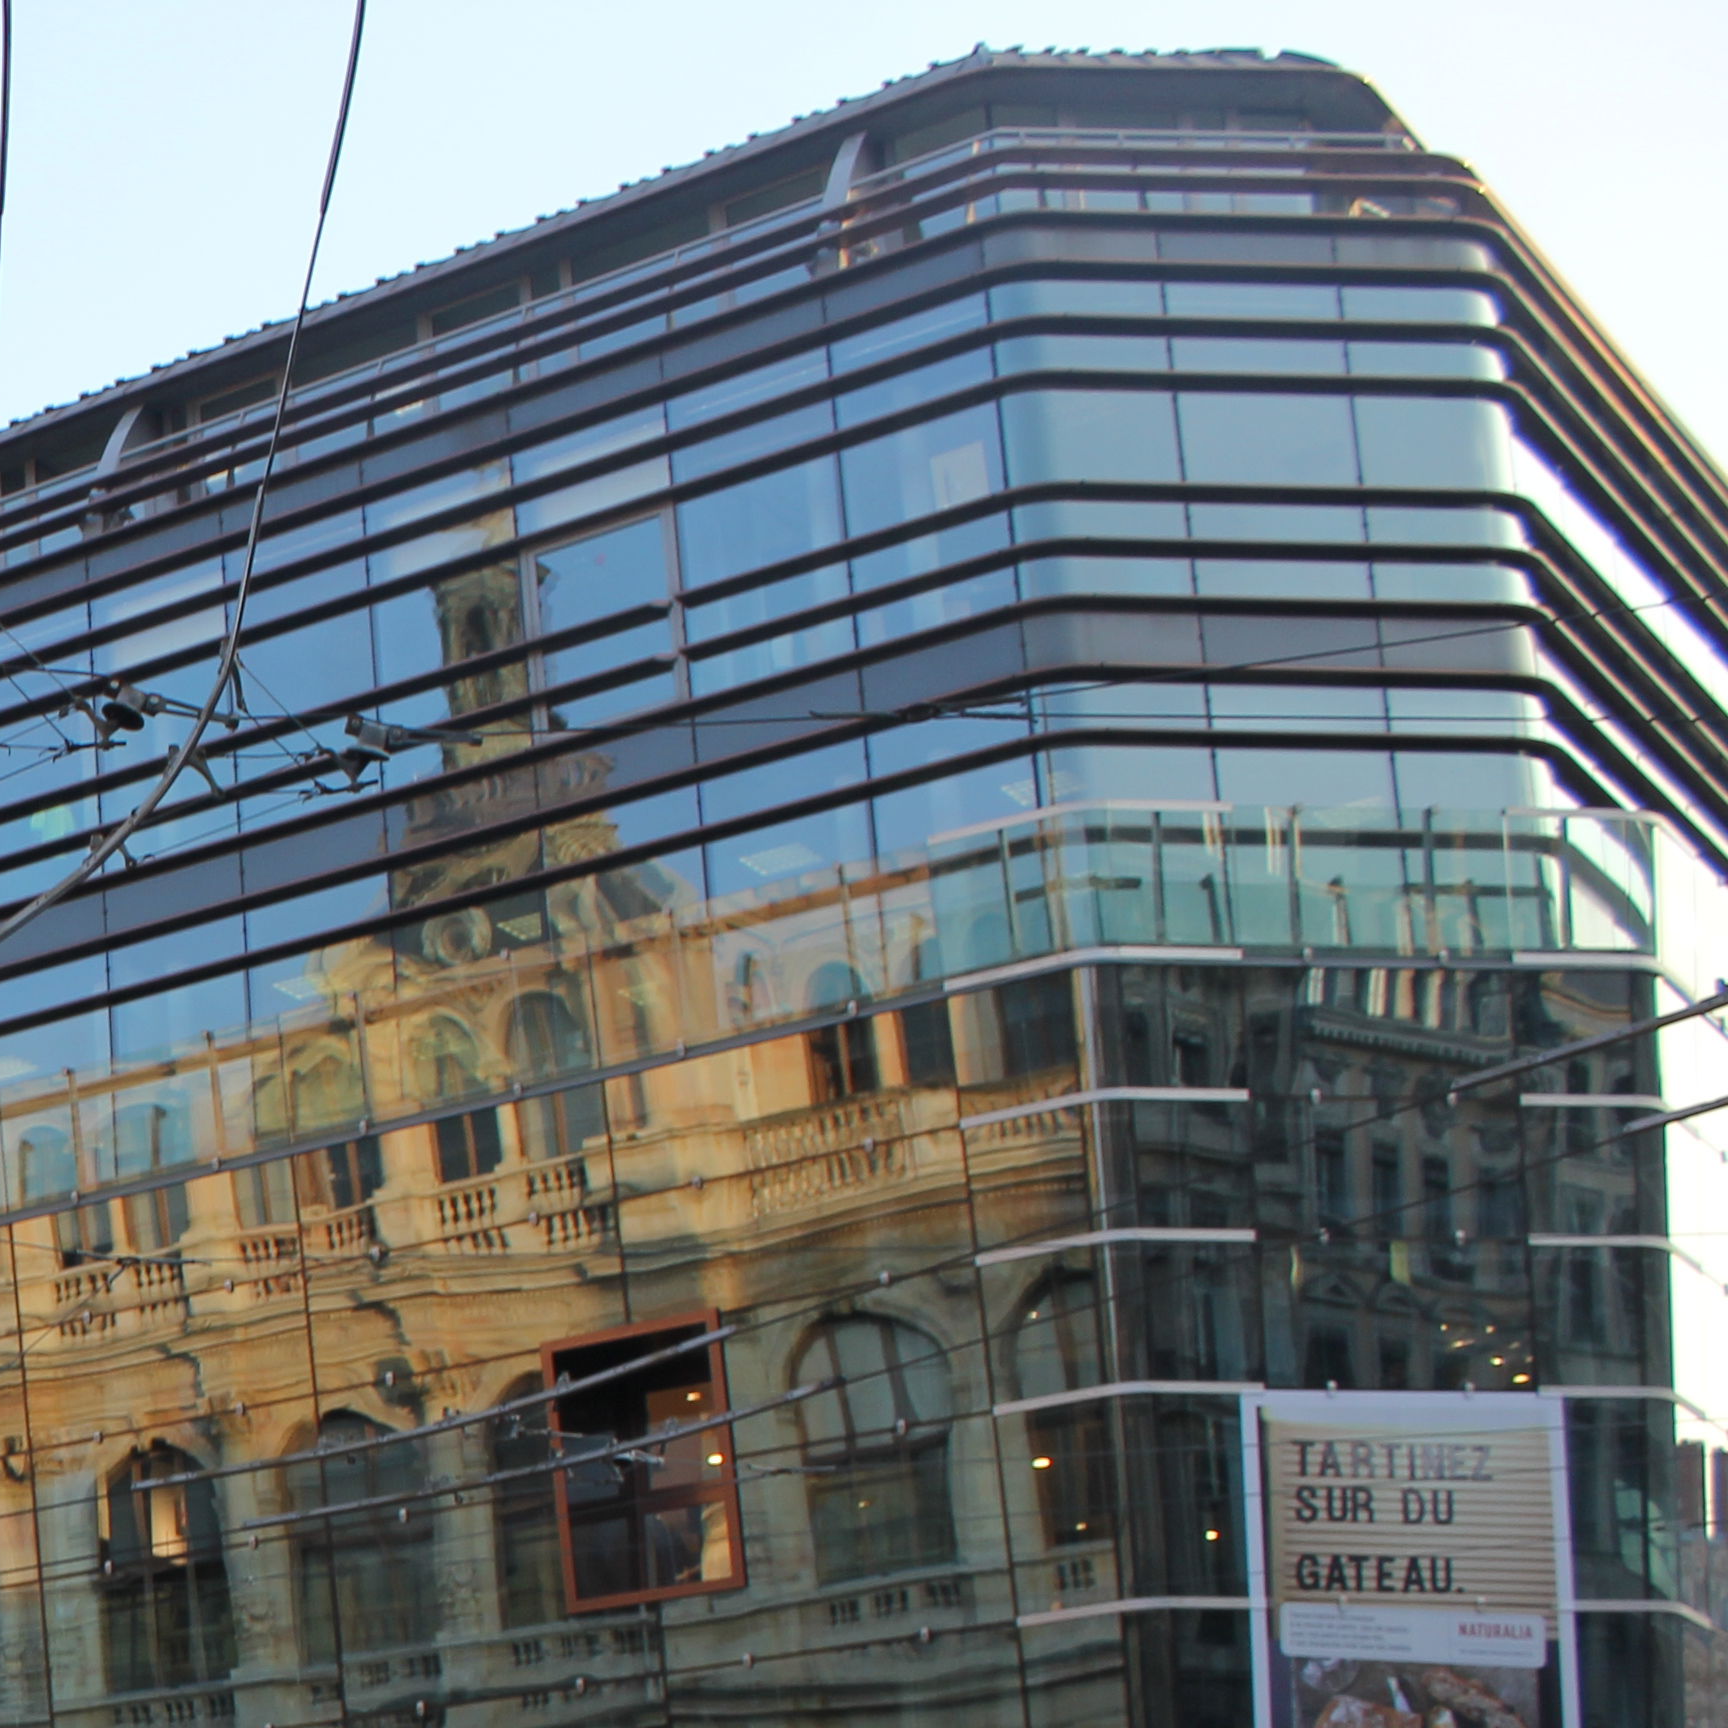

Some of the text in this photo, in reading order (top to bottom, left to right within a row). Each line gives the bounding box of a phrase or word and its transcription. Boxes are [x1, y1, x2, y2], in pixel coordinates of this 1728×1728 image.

[1291, 1441, 1493, 1482] TARTINEZ
[1295, 1485, 1454, 1525] SUR DU
[1296, 1554, 1466, 1594] GATEAU.
[1458, 1622, 1534, 1639] NATURALIA
